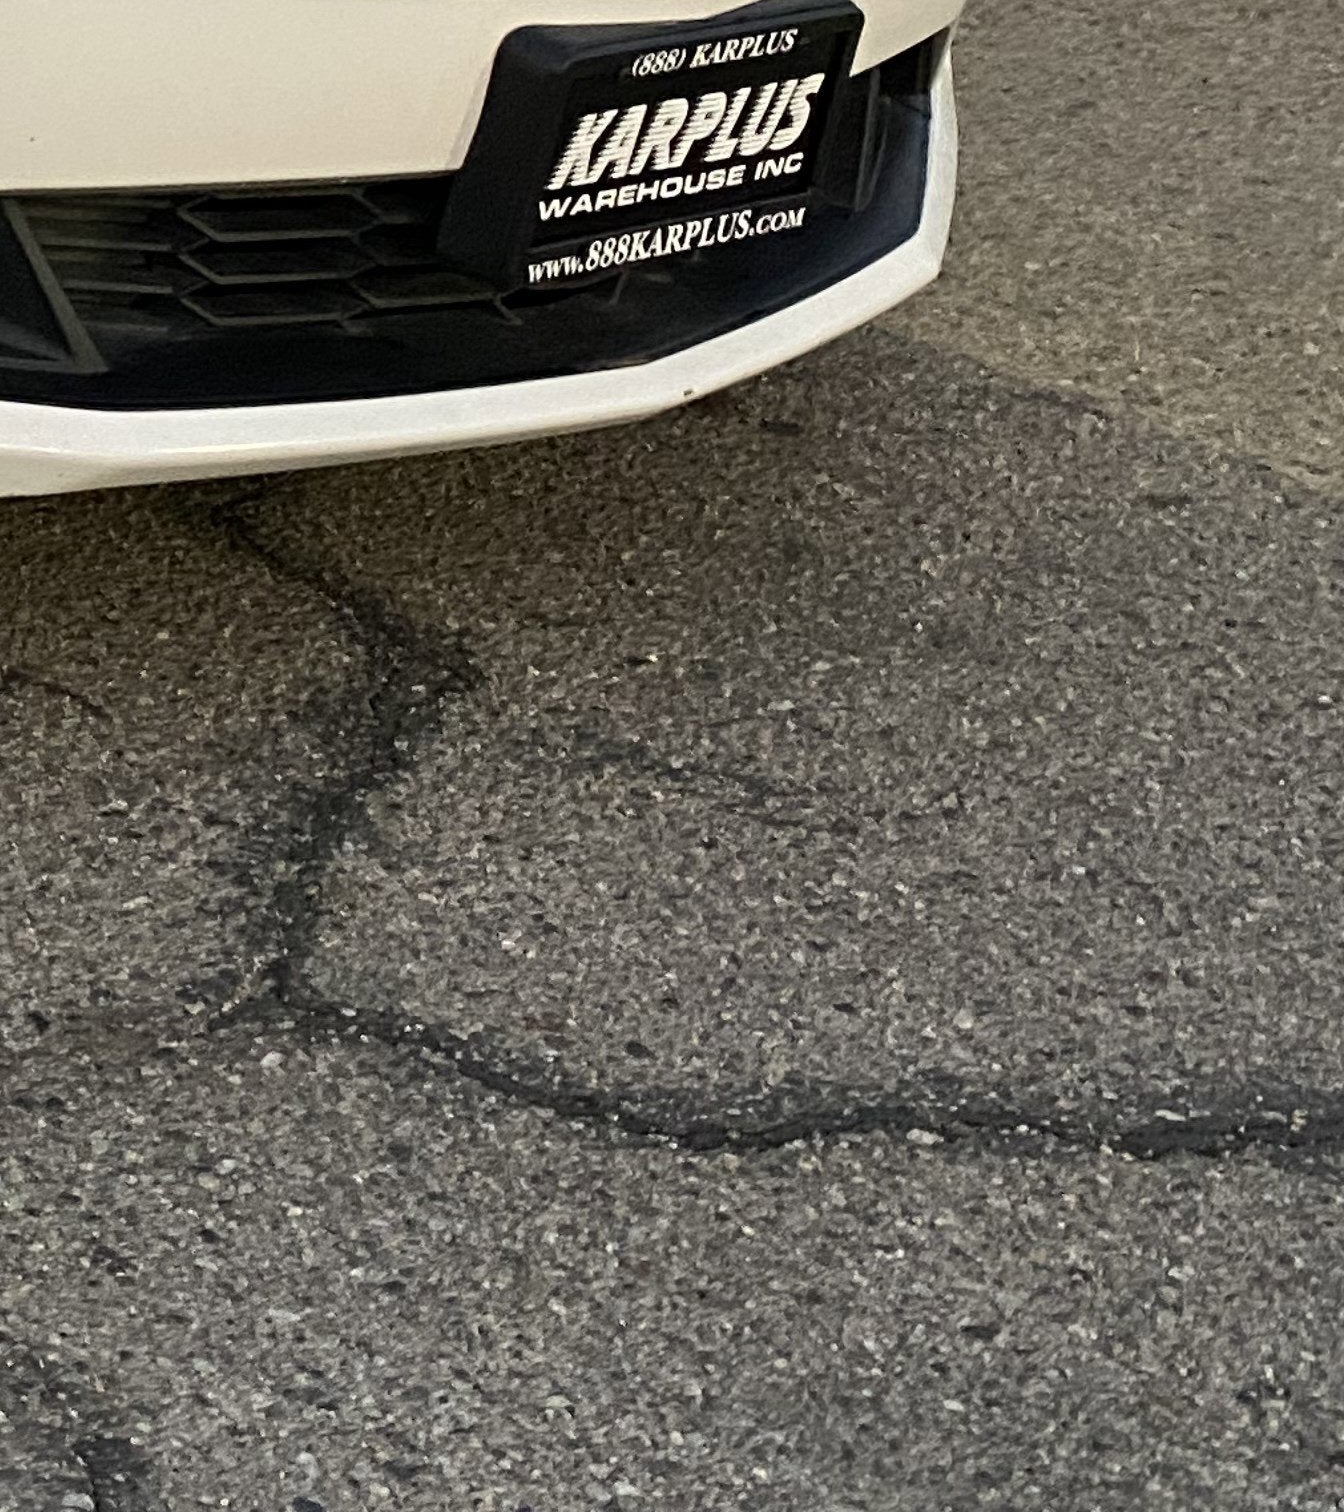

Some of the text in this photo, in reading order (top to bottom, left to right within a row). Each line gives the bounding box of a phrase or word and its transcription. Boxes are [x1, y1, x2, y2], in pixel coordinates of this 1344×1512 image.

[631, 28, 799, 77] (888) KARPLUS
[544, 73, 826, 191] KARPLUS
[538, 152, 804, 221] WAREHOUSE INC
